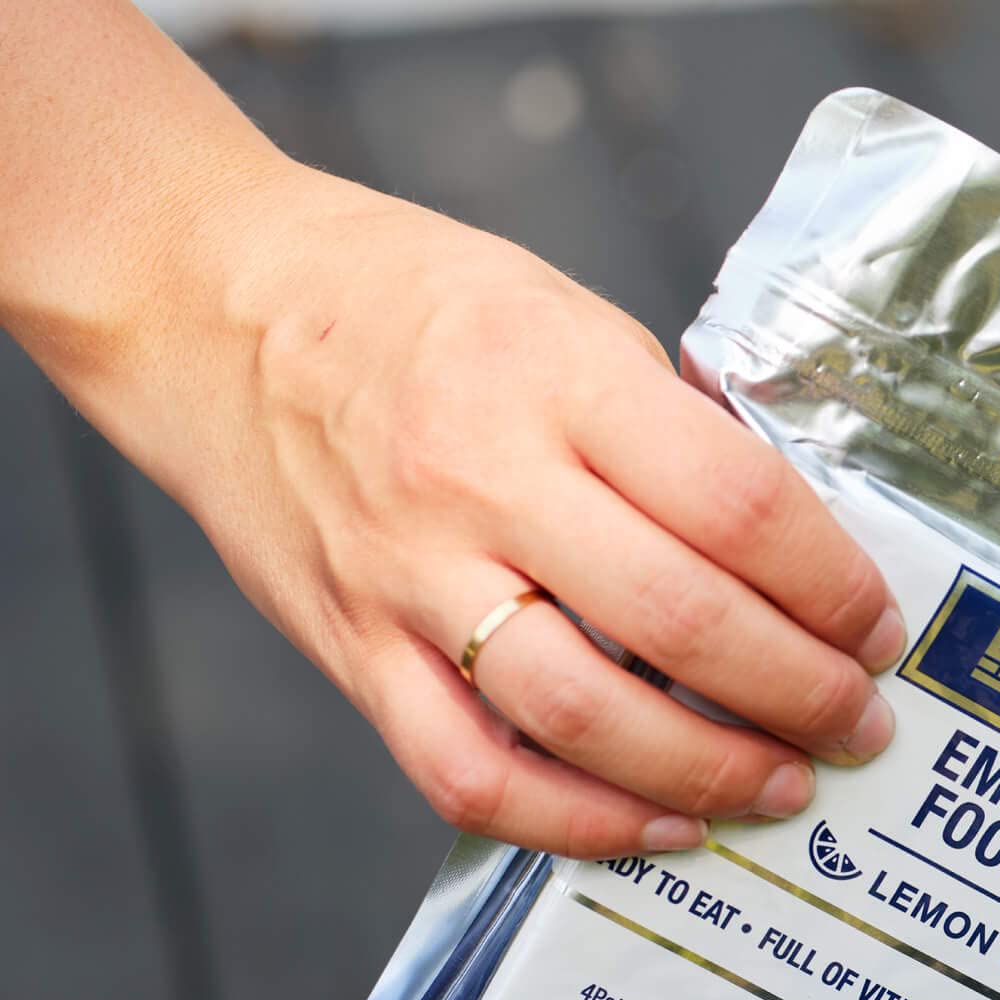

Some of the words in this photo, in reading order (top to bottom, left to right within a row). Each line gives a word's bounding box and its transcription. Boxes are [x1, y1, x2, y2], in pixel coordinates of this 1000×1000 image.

[654, 870, 690, 904] TO
[688, 890, 742, 930] EAT
[757, 928, 817, 976] FULL
[821, 961, 860, 992] OF
[868, 870, 999, 955] LEMON
